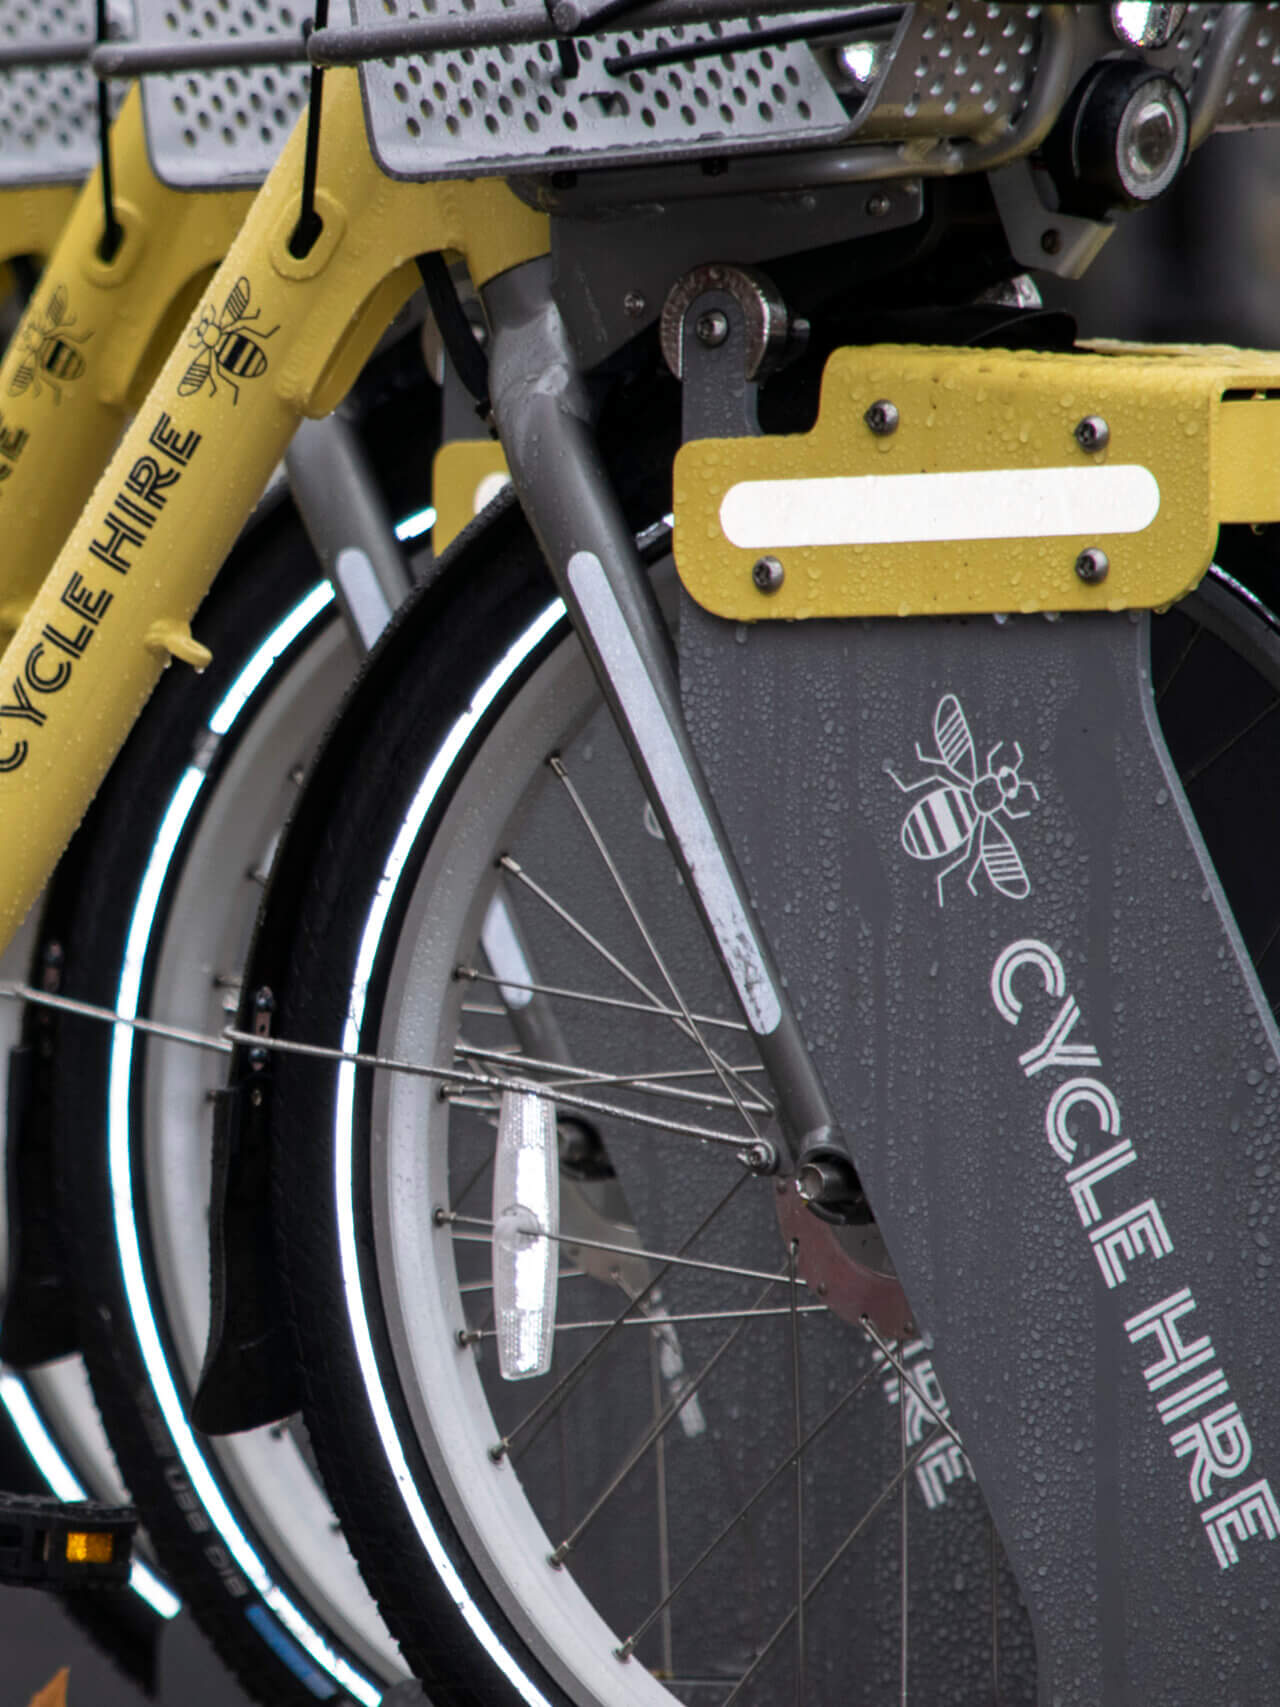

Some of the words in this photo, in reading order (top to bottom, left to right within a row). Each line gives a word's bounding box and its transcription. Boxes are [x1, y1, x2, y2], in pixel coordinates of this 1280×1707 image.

[88, 412, 202, 575] HIRE
[991, 939, 1175, 1289] CYCLE
[1124, 1287, 1280, 1569] HIRE
